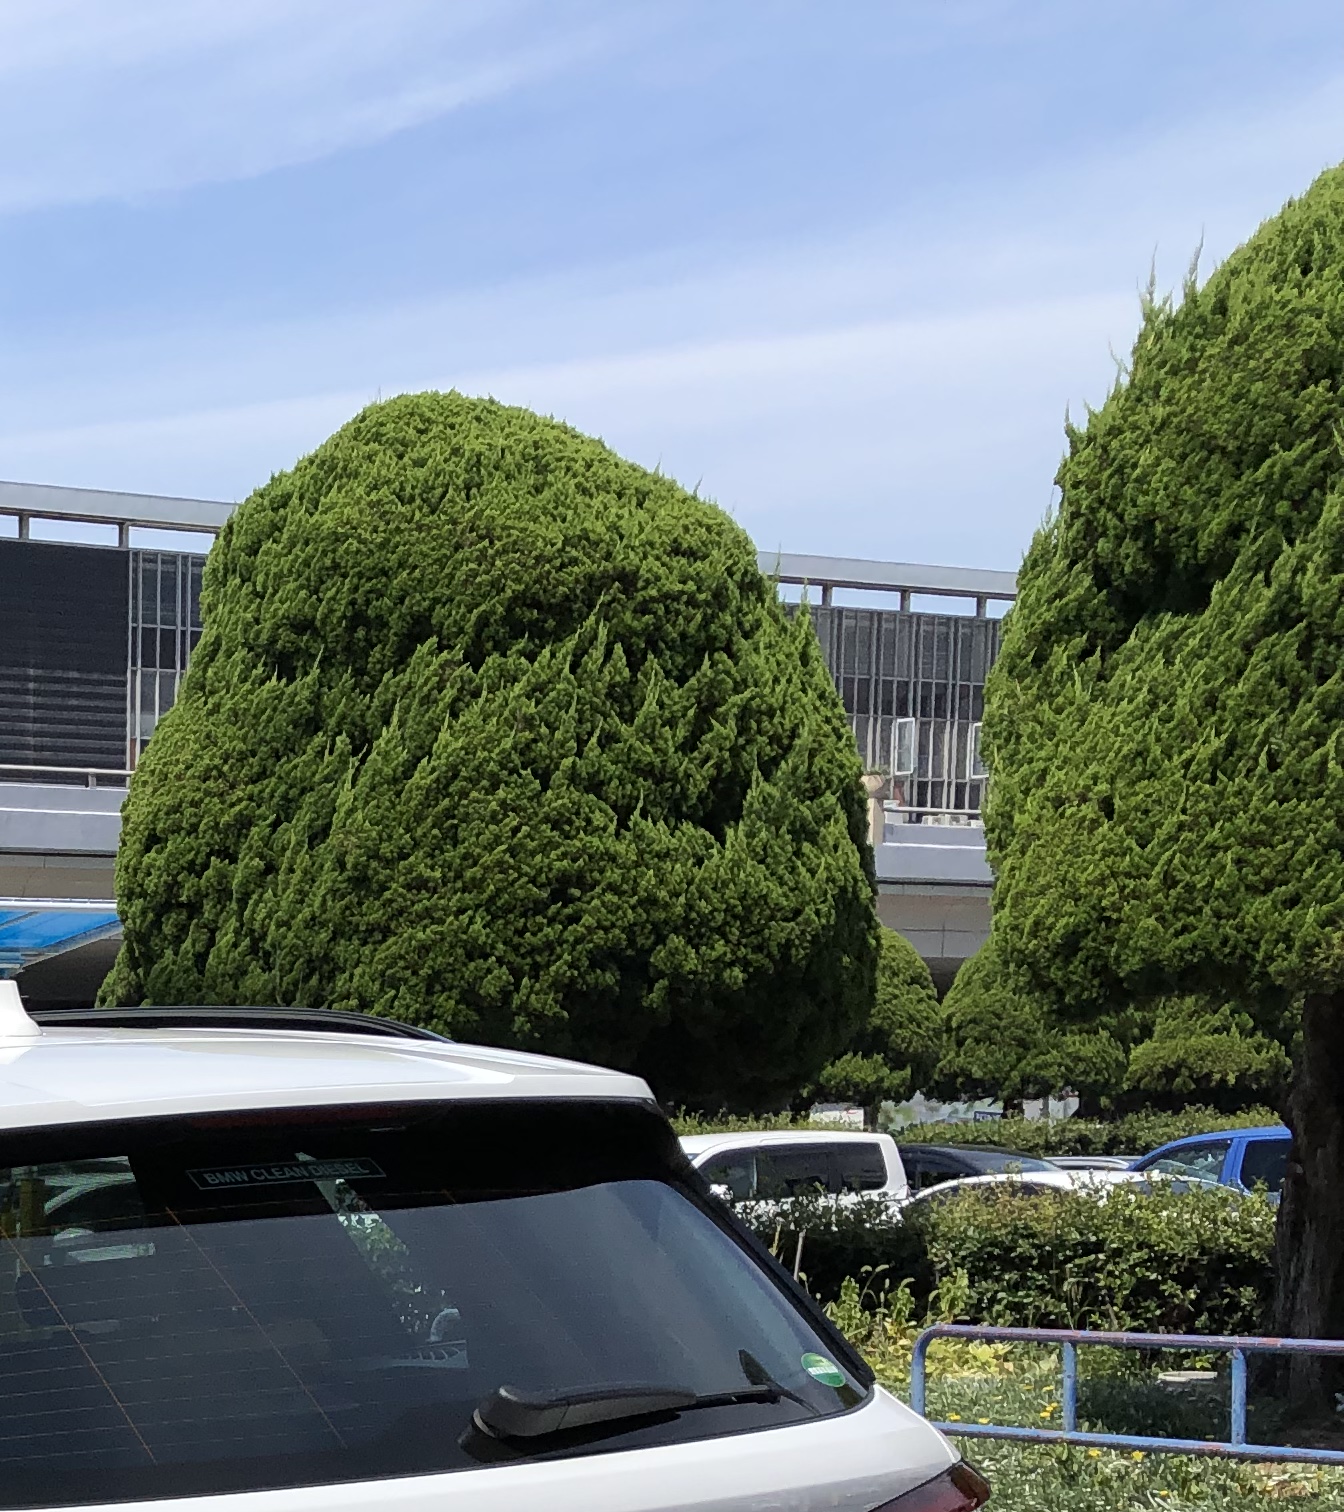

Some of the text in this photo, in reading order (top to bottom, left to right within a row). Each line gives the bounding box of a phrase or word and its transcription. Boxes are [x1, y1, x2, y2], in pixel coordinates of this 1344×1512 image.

[203, 1161, 370, 1185] BMW CLEAN DIESEL
